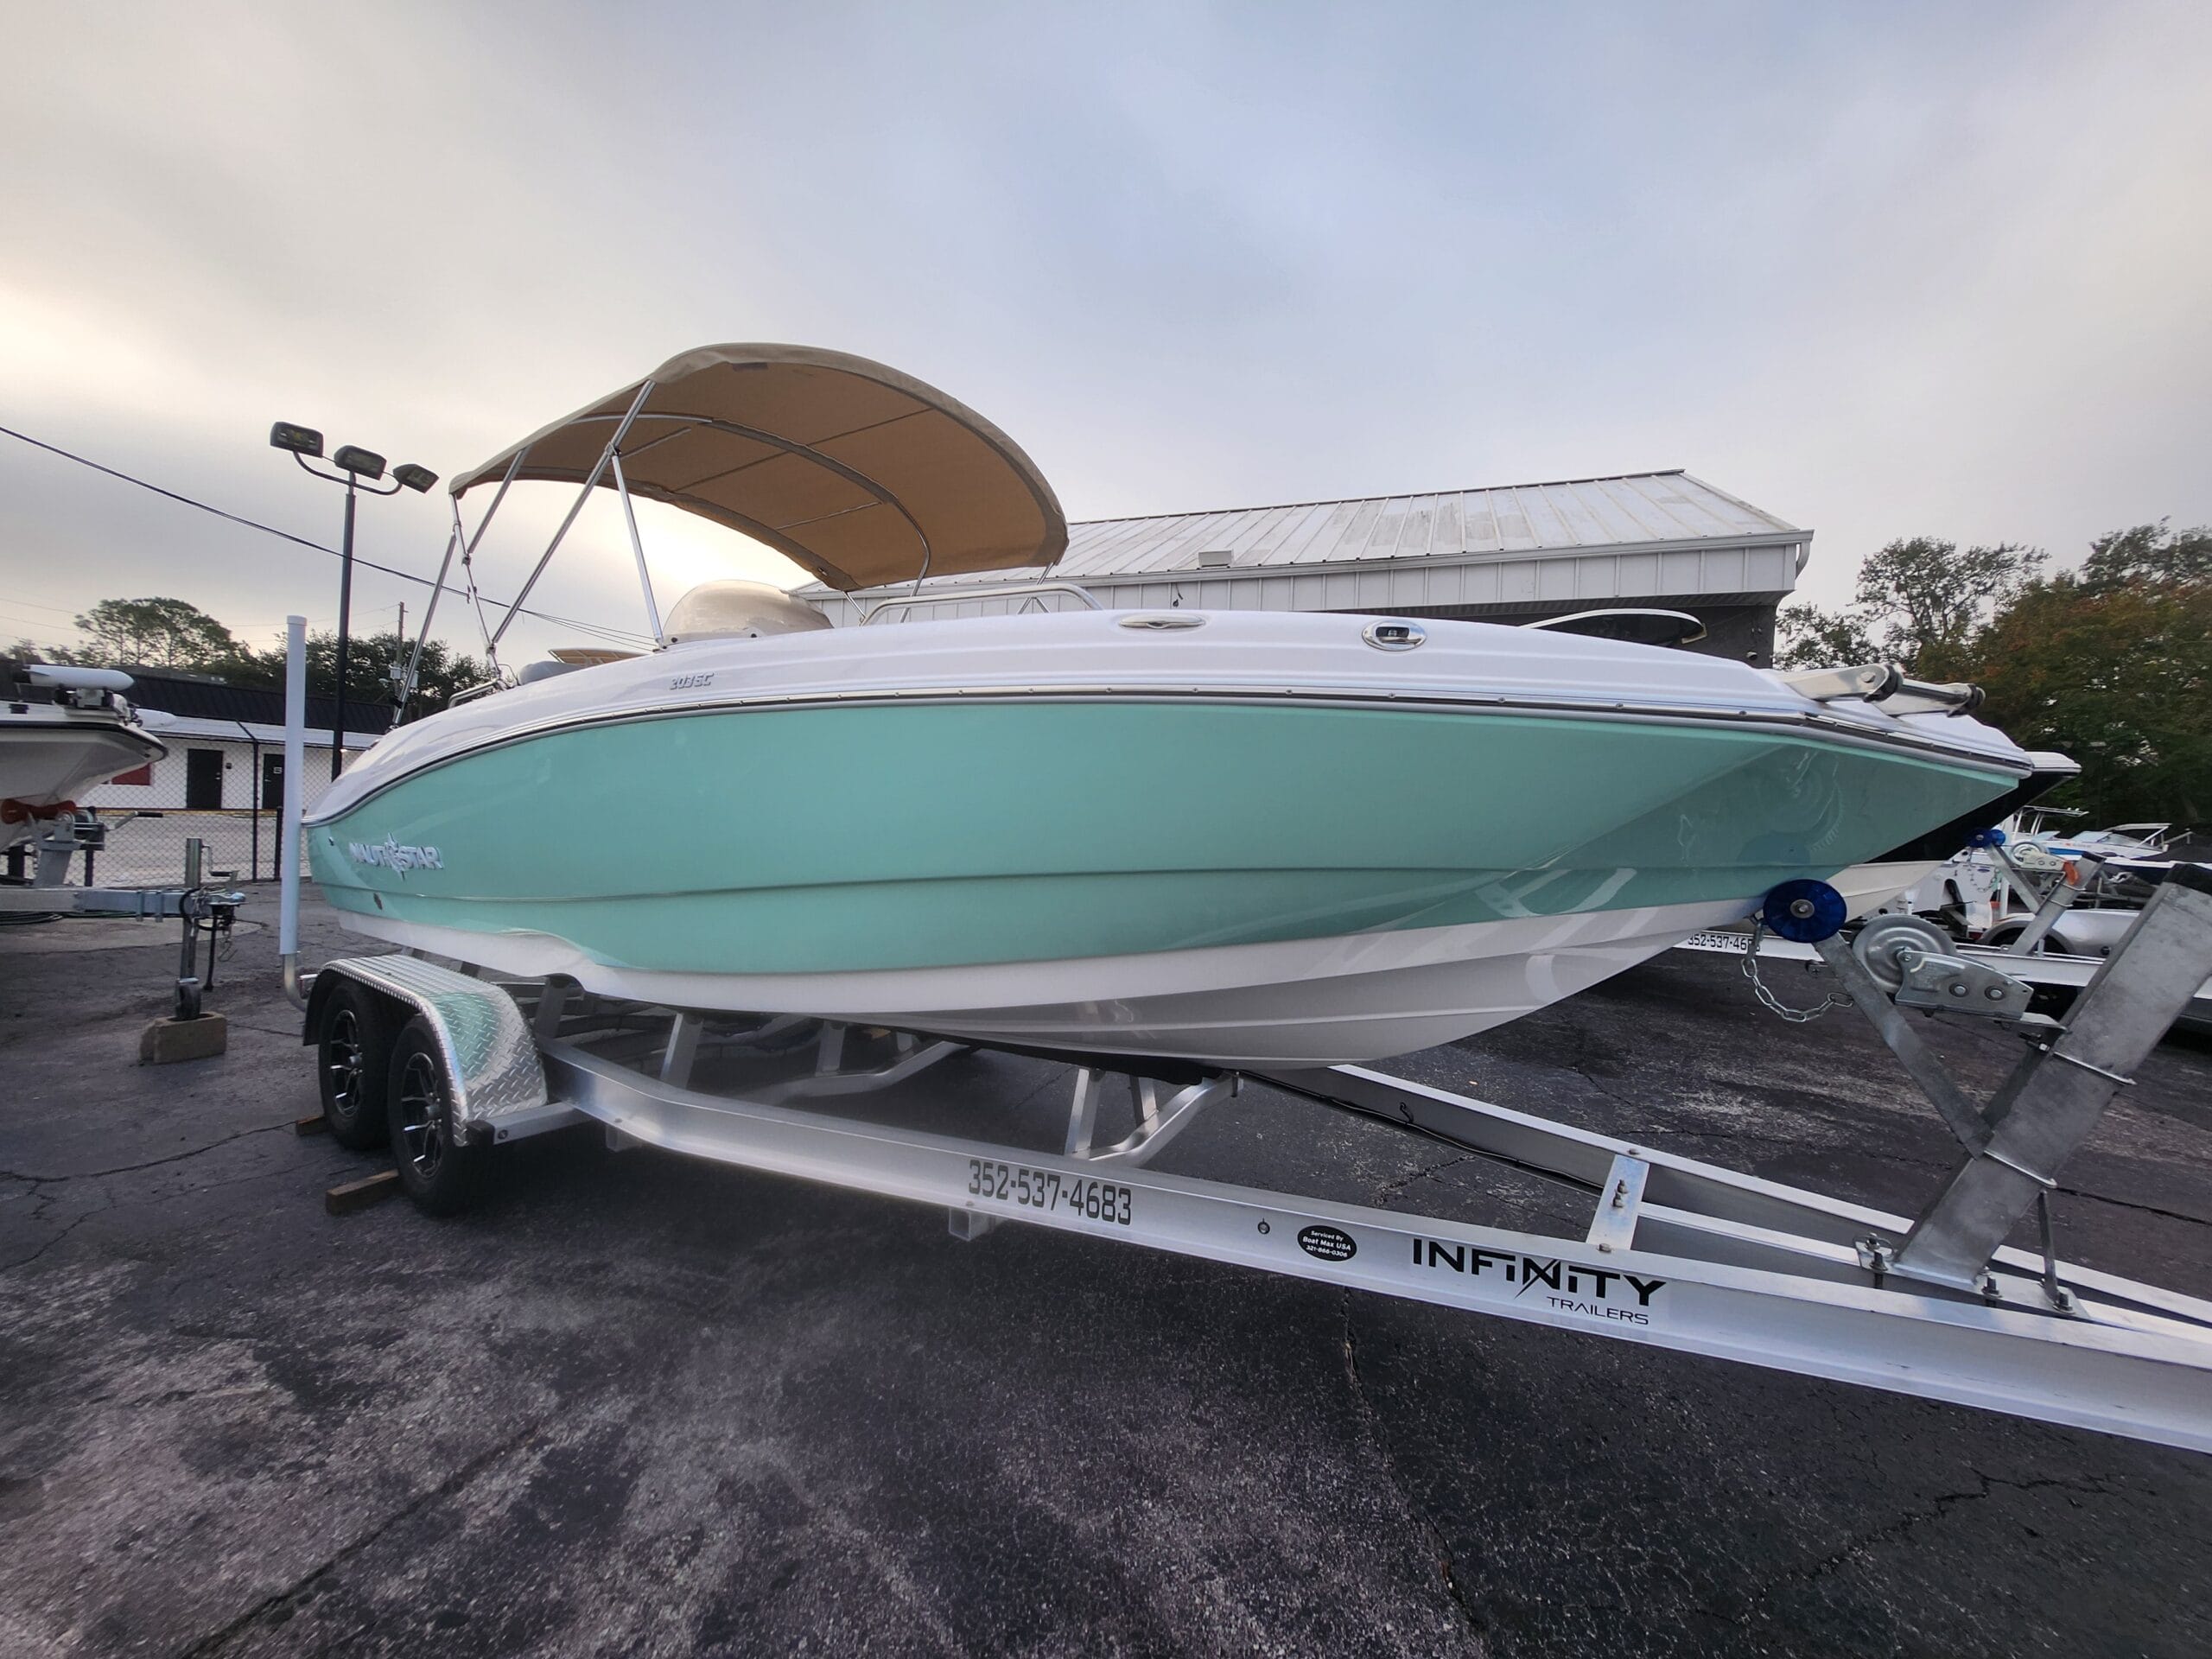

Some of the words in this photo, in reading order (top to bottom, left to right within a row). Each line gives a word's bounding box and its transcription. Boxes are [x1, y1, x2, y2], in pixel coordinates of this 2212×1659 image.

[1688, 934, 1760, 952] 352-537-46
[969, 1160, 1132, 1226] 352-537-4683
[1302, 1236, 1319, 1244] Boat
[1319, 1239, 1335, 1248] Max
[1336, 1242, 1351, 1251] USA
[1311, 1230, 1335, 1240] Serviced
[1413, 1238, 1667, 1306] INFINITY
[1547, 1296, 1649, 1325] TRAILERS
